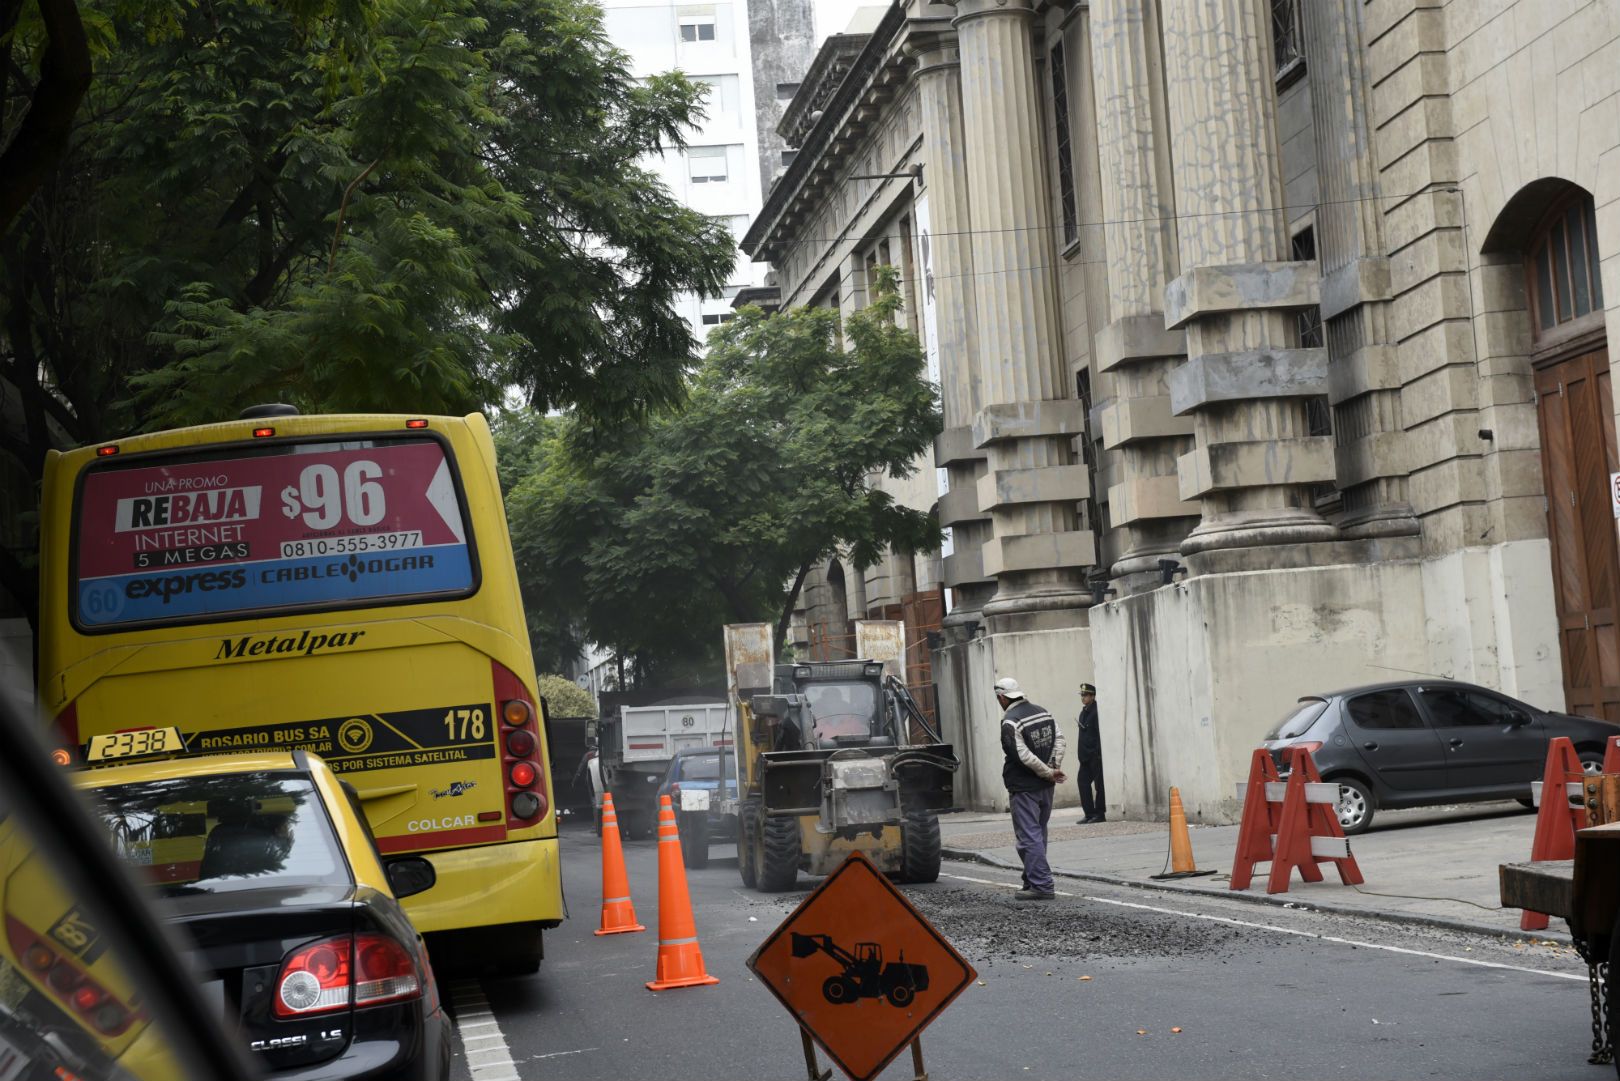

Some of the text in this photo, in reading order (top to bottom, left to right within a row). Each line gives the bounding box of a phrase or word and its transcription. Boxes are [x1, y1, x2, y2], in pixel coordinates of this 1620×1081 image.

[145, 475, 228, 493] UNA PROMO
[281, 460, 386, 530] $96
[132, 489, 247, 528] REBAJA
[135, 525, 246, 550] INTERNET
[283, 532, 420, 558] 0810-555-3977
[138, 543, 248, 567] 5 MEGAS
[126, 569, 246, 604] express
[213, 630, 366, 660] Metalpar
[444, 709, 485, 740] 178
[682, 716, 695, 727] 80
[102, 730, 166, 757] 2338
[201, 732, 269, 748] ROSARIO
[274, 728, 304, 743] BUS
[309, 726, 330, 739] SA
[342, 760, 364, 771] POR
[366, 755, 412, 769] SISTEMA
[415, 750, 467, 763] SATELITAL
[407, 815, 475, 832] COLCAR
